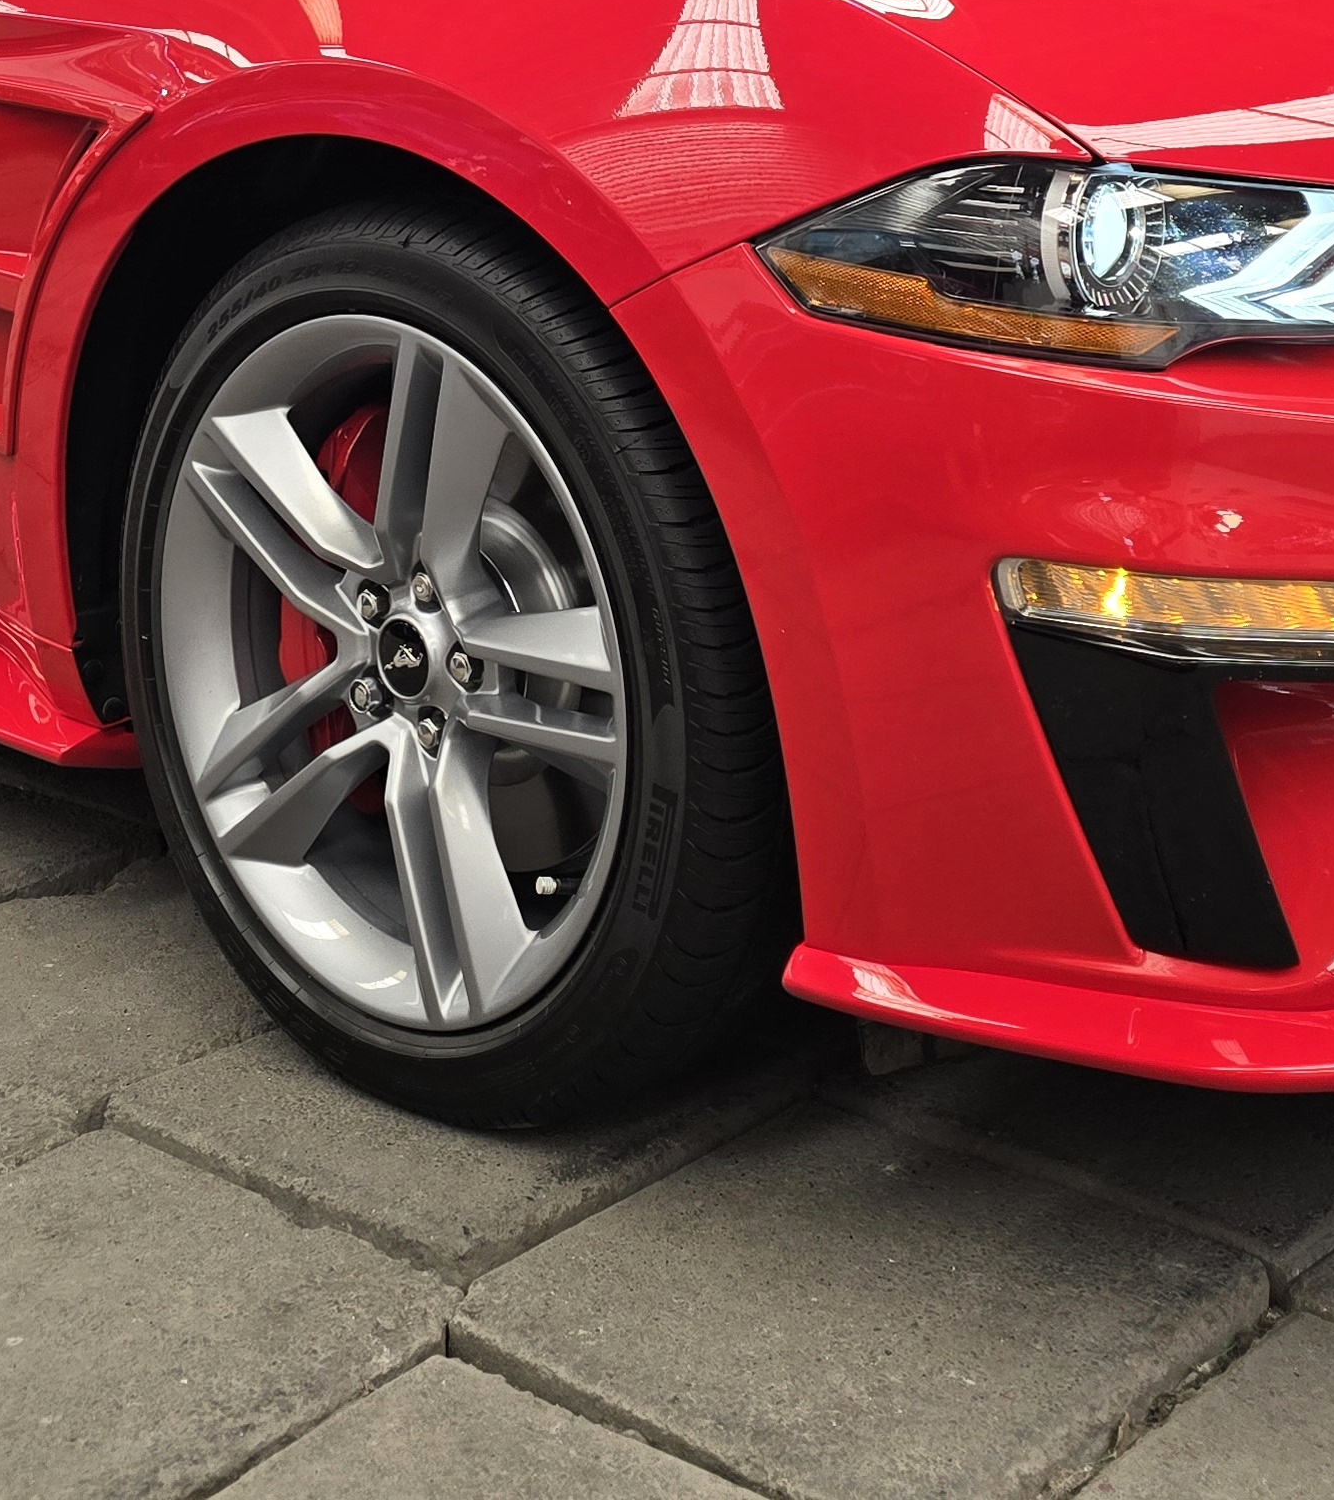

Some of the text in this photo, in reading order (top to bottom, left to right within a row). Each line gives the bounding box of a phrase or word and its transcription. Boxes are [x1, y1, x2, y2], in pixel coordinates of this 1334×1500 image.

[205, 276, 283, 345] 255/40
[287, 260, 324, 284] ZR
[334, 259, 359, 275] 19
[631, 782, 679, 921] PIRELLI
